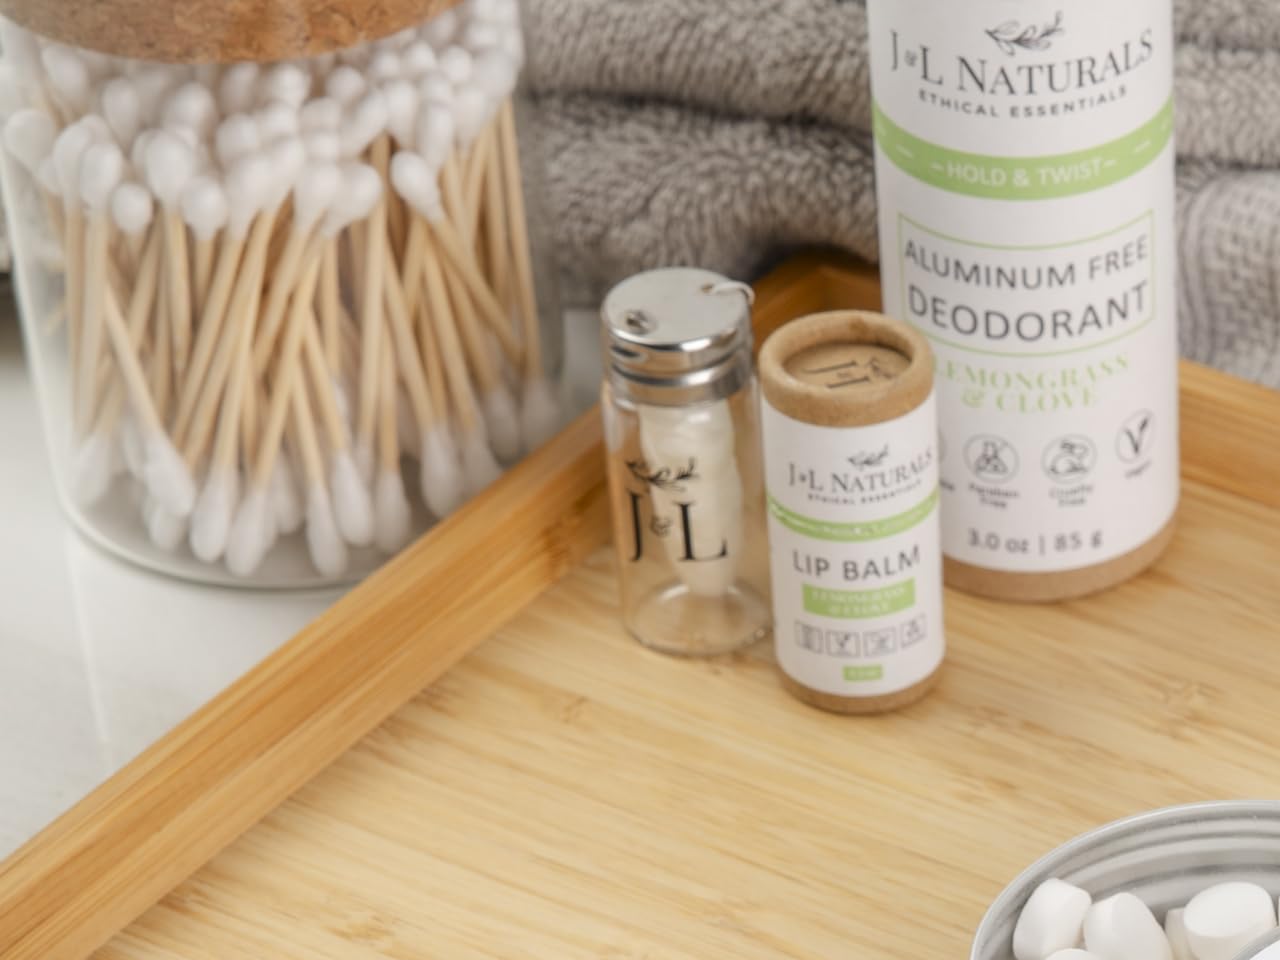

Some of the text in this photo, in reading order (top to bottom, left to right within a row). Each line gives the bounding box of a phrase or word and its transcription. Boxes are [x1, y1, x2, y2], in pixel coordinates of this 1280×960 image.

[957, 29, 1153, 96] NATURALS
[919, 85, 1127, 118] ETHICAL ESSENTIALS
[947, 159, 1101, 188] HOLD & TWIST
[904, 234, 1148, 290] ALUMINUM FREE
[908, 280, 1148, 342] DEODORANT
[792, 543, 920, 582] LIP BALM
